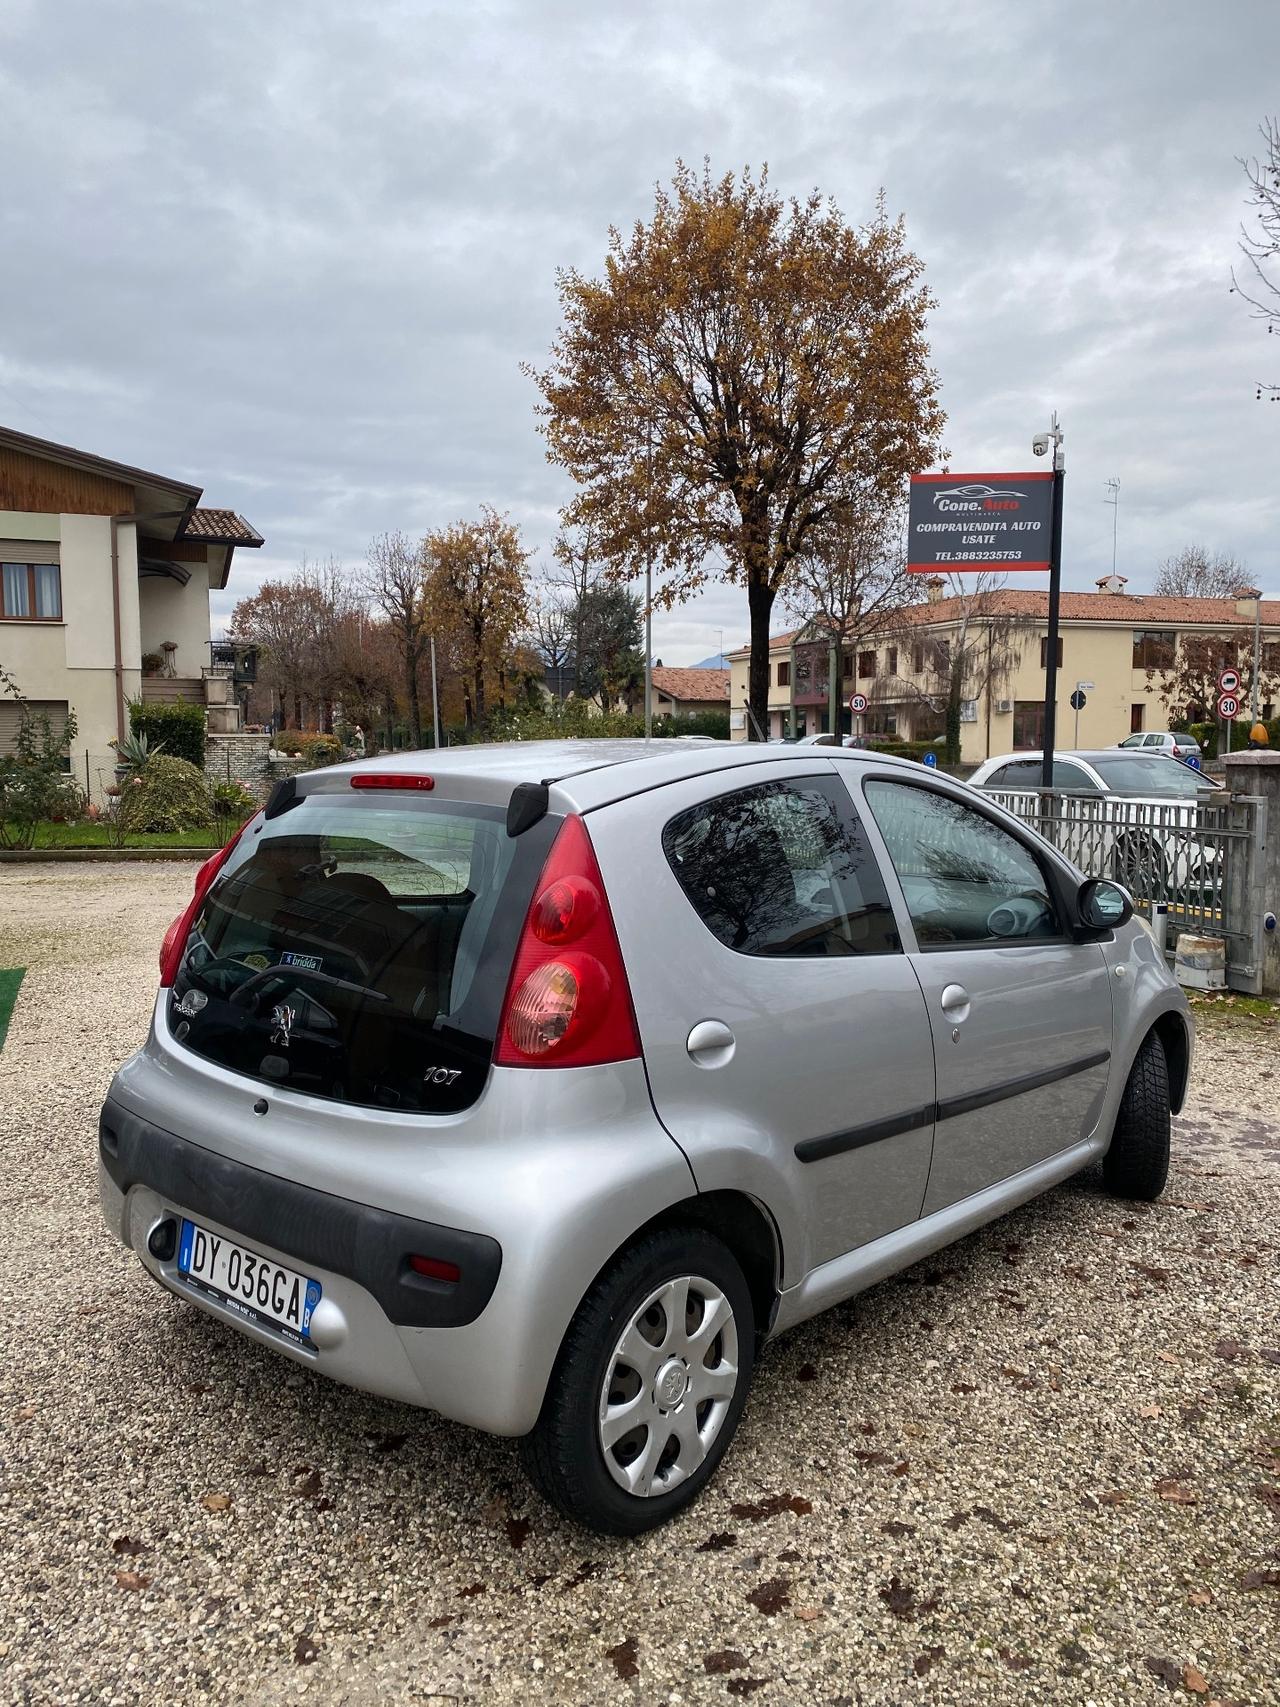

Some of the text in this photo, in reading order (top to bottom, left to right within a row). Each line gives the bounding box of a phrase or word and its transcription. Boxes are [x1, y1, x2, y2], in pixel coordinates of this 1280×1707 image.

[916, 521, 1041, 533] COMPRAVENDITA AUTO
[961, 535, 996, 544] USATE
[935, 551, 1022, 561] TEL.3883235753
[853, 698, 864, 708] 50
[1223, 701, 1235, 713] 30
[424, 1066, 462, 1085] 107
[192, 1230, 300, 1325] DY 036GA
